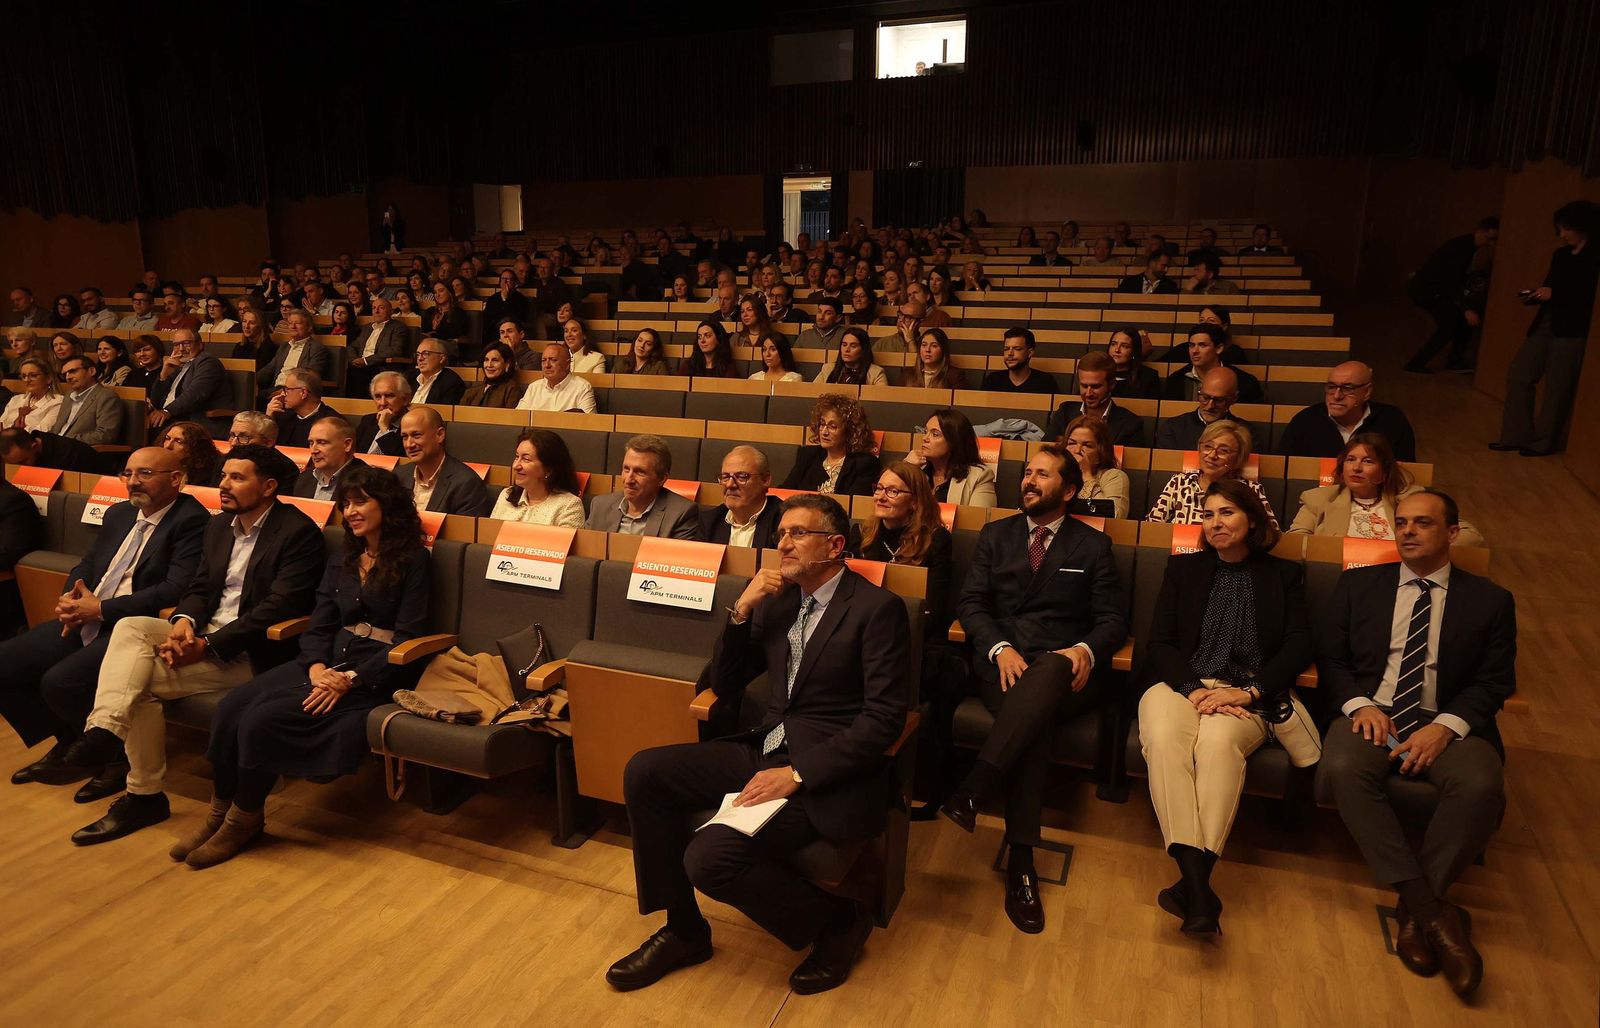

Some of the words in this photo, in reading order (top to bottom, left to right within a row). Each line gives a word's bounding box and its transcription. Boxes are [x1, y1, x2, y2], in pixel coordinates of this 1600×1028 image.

[496, 543, 525, 554] ASIENTO
[525, 547, 566, 559] RESERVADO
[636, 561, 669, 572] ASIENTO
[669, 565, 715, 578] RESERVADO
[520, 573, 552, 582] TERMINALS
[666, 592, 703, 603] TERMINALS
